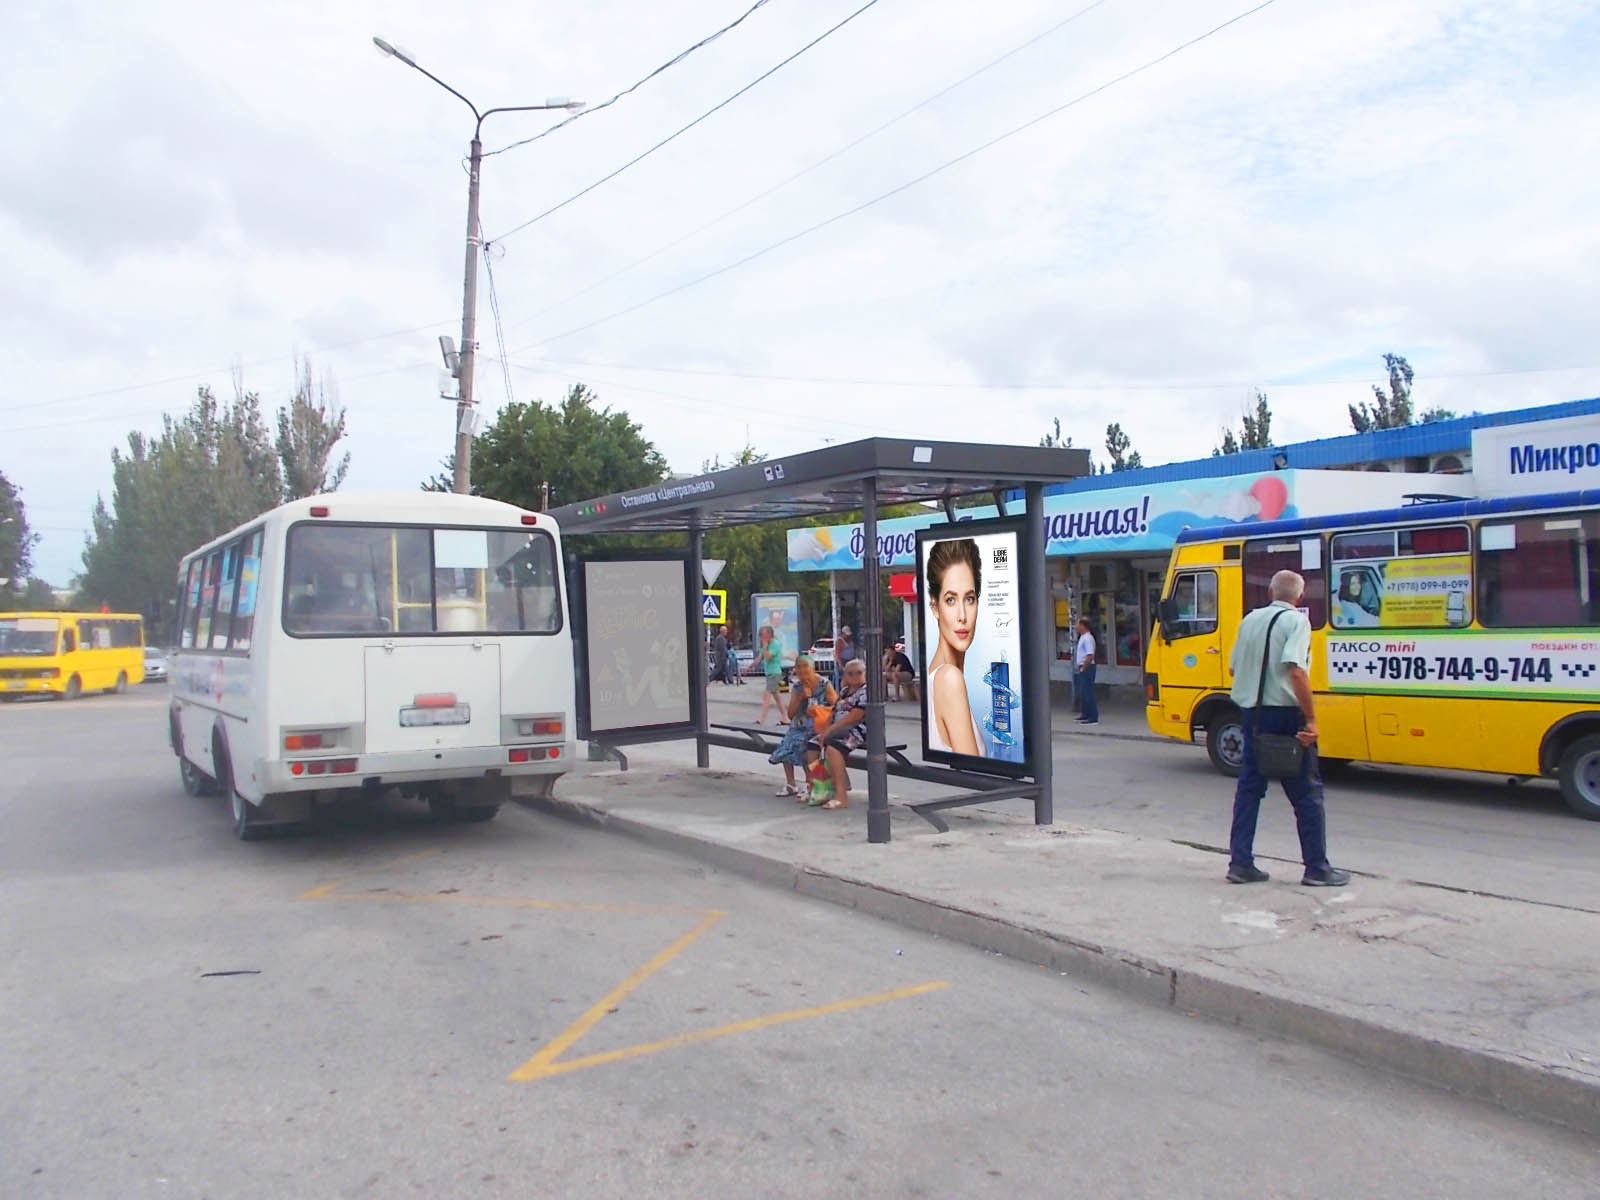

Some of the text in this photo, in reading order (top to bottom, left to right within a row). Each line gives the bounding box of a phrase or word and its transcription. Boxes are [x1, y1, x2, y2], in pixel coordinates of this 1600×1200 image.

[1510, 443, 1600, 474] Микро
[621, 480, 715, 508] Остановка «Центральная»
[850, 528, 916, 564] Фодос
[1330, 641, 1416, 653] ТАКСО mini
[1365, 656, 1553, 682] +7978-744-9-744
